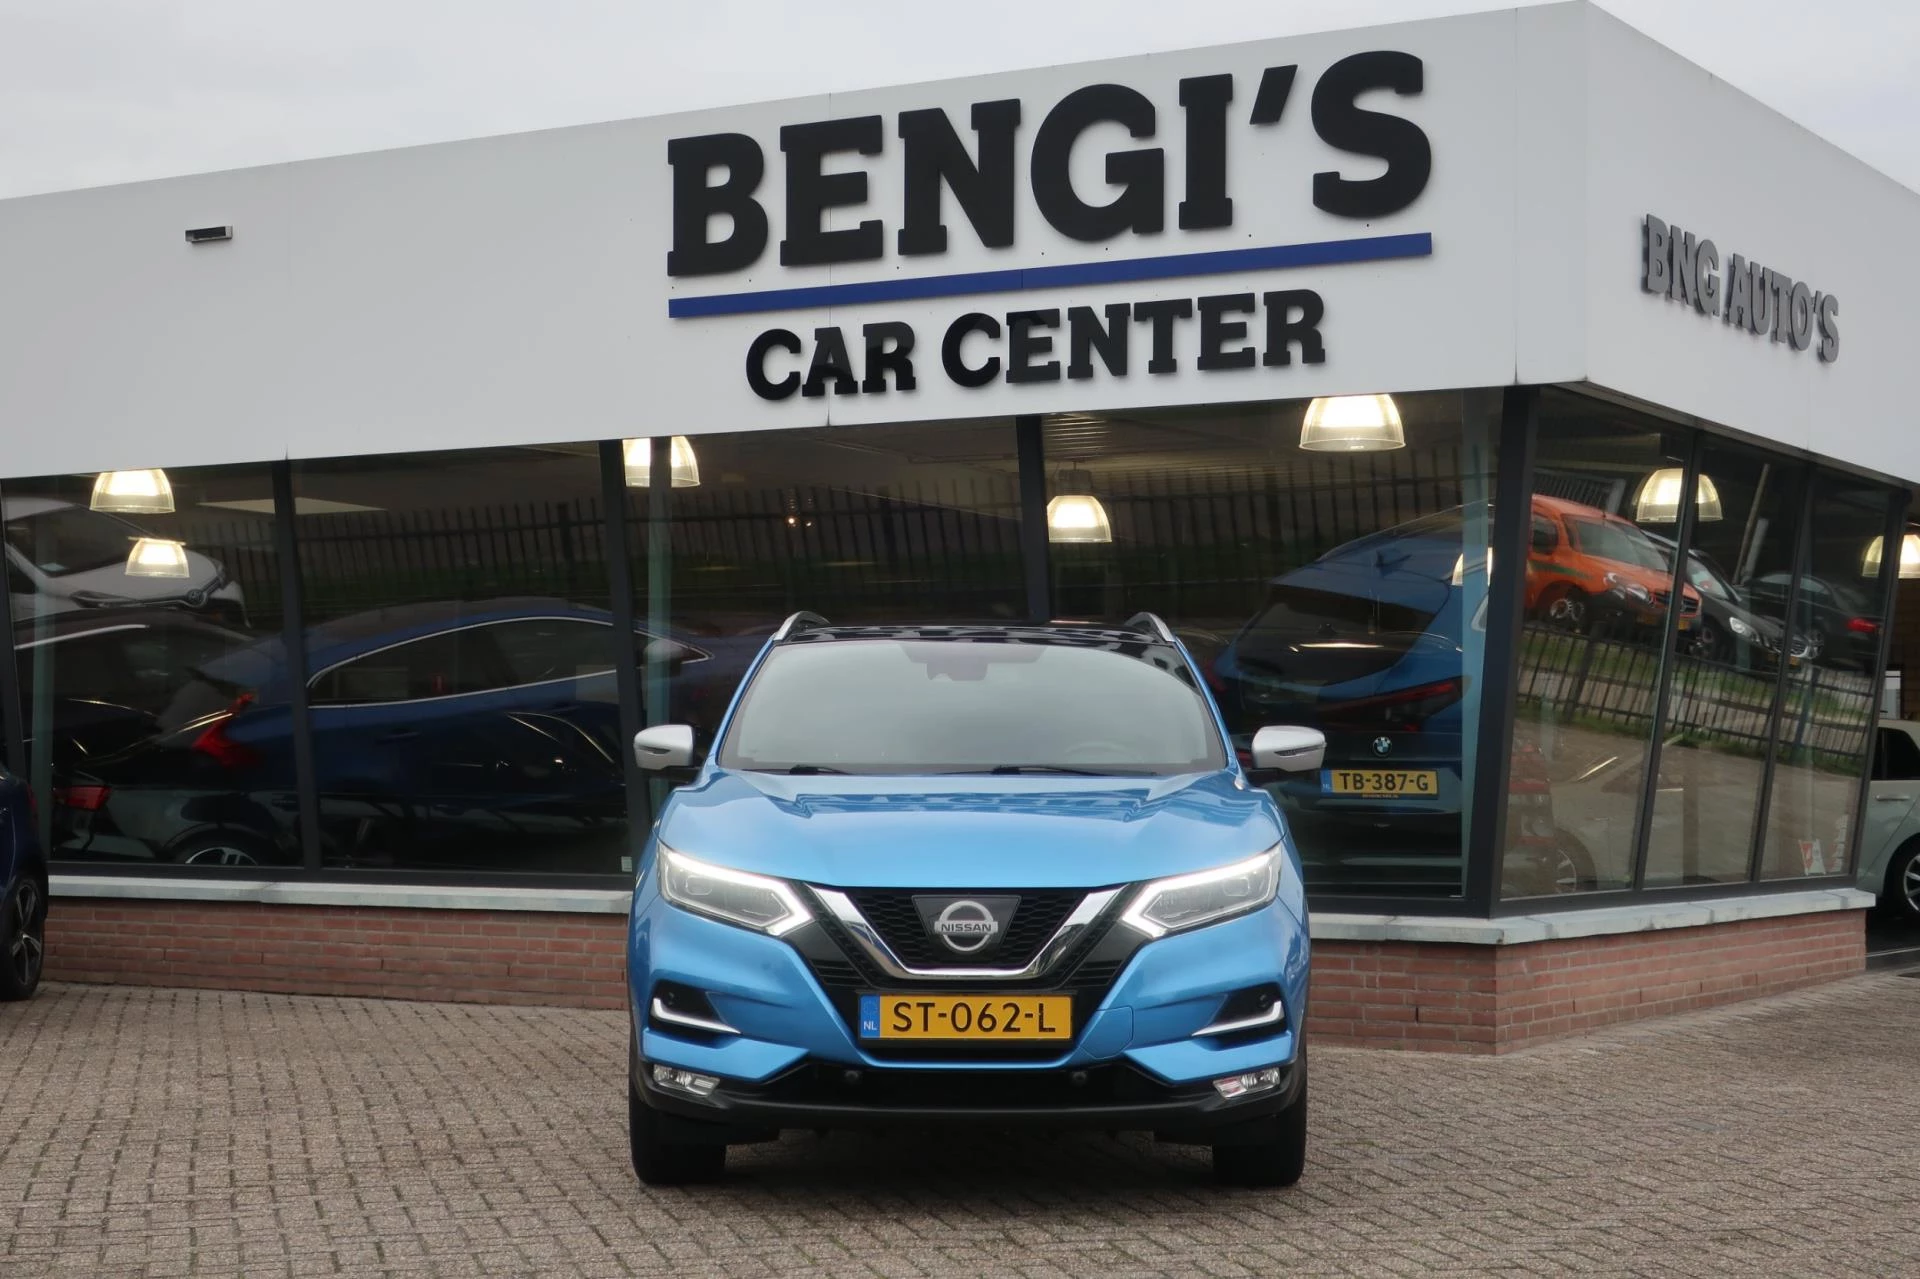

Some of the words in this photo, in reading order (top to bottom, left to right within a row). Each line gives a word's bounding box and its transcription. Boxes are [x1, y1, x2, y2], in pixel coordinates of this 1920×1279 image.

[667, 50, 1432, 276] BENGI'S
[1642, 213, 1720, 317] BNG
[1724, 253, 1840, 363] AUTO'S
[746, 321, 916, 400] CAR
[941, 289, 1325, 388] CENTER
[1339, 773, 1428, 791] TB-387-G
[941, 923, 992, 932] NISSAN
[863, 1021, 877, 1031] NL
[893, 1002, 1055, 1033] ST-062-L
